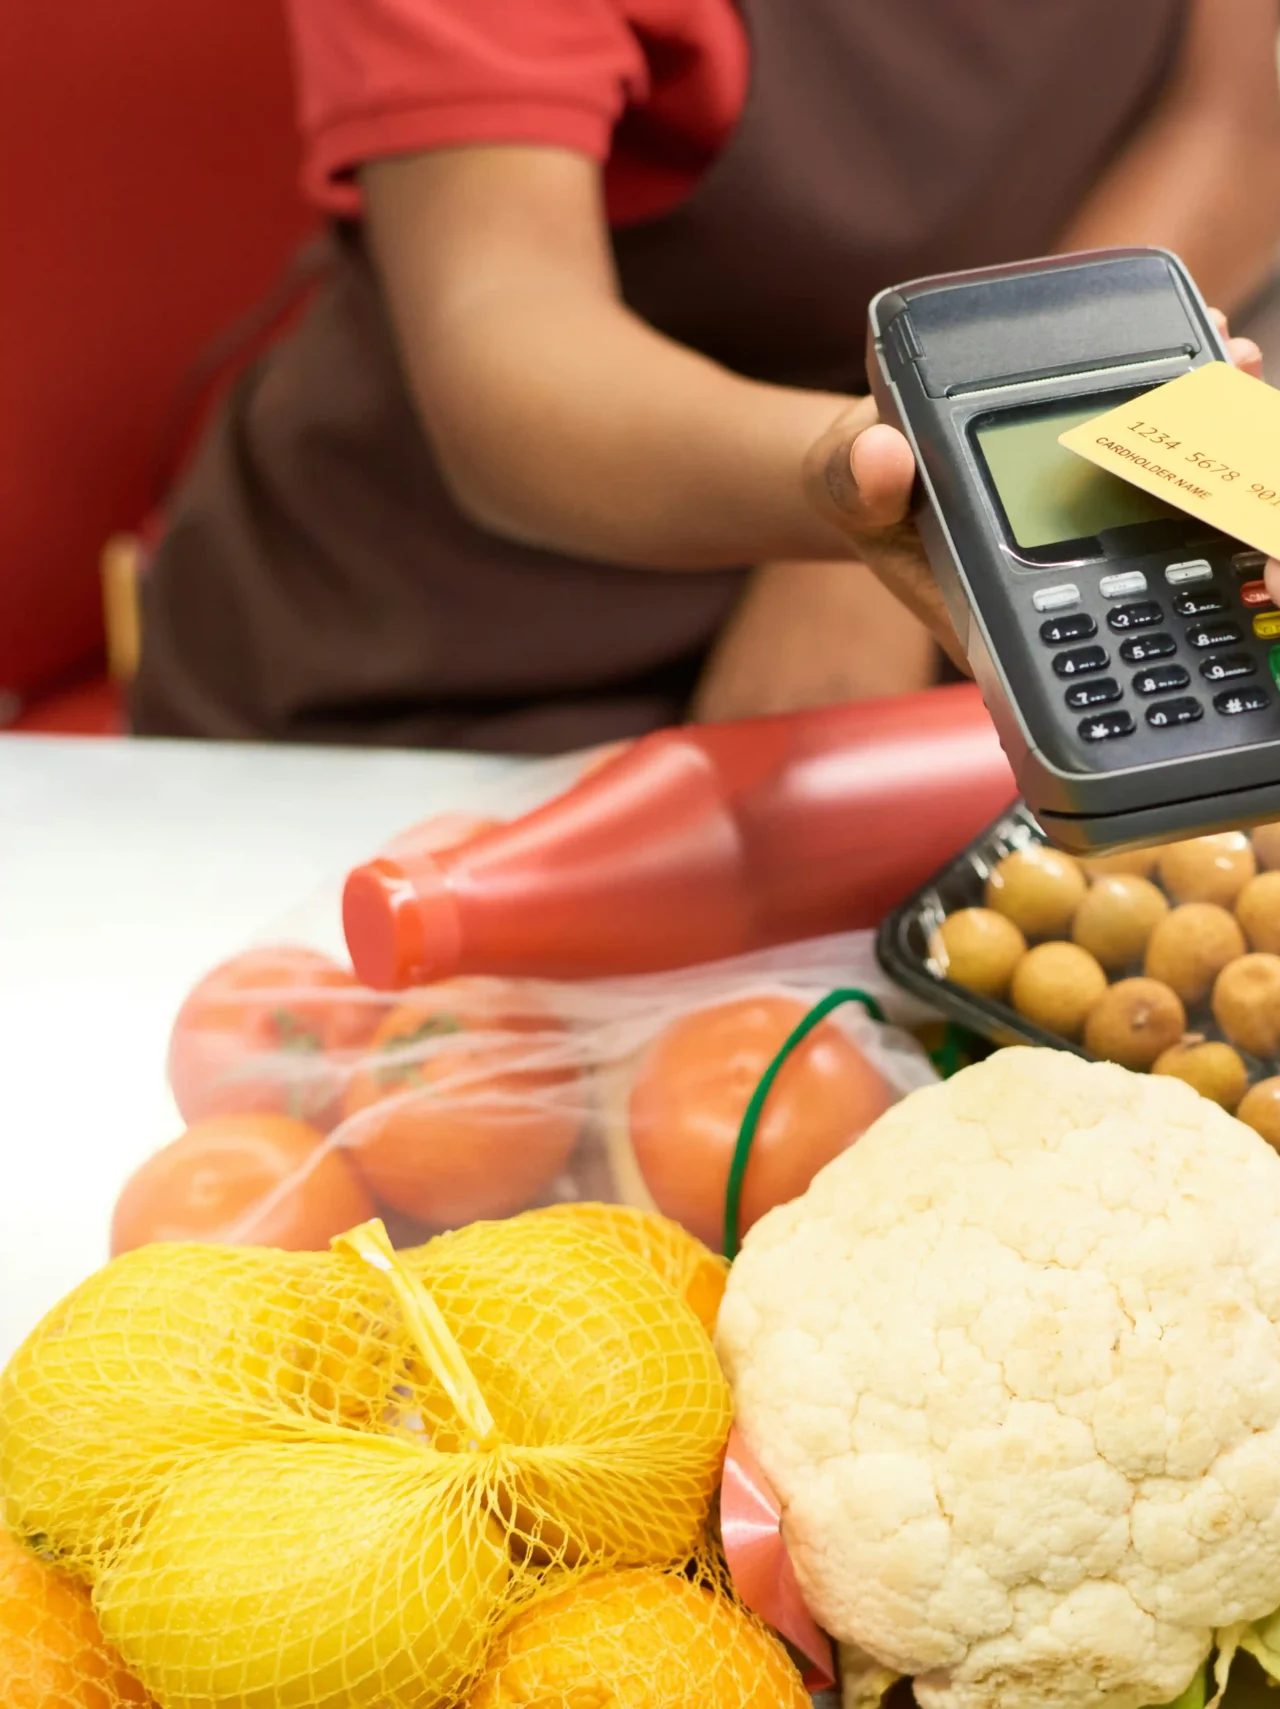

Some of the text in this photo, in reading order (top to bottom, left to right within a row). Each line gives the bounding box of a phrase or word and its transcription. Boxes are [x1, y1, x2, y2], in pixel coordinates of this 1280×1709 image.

[1127, 421, 1182, 450] 1234
[1184, 452, 1241, 482] 5678
[1095, 437, 1213, 500] CARDHOLDER NAME
[1184, 602, 1197, 613] 3
[1132, 646, 1145, 659] 5
[1076, 691, 1088, 704] 7
